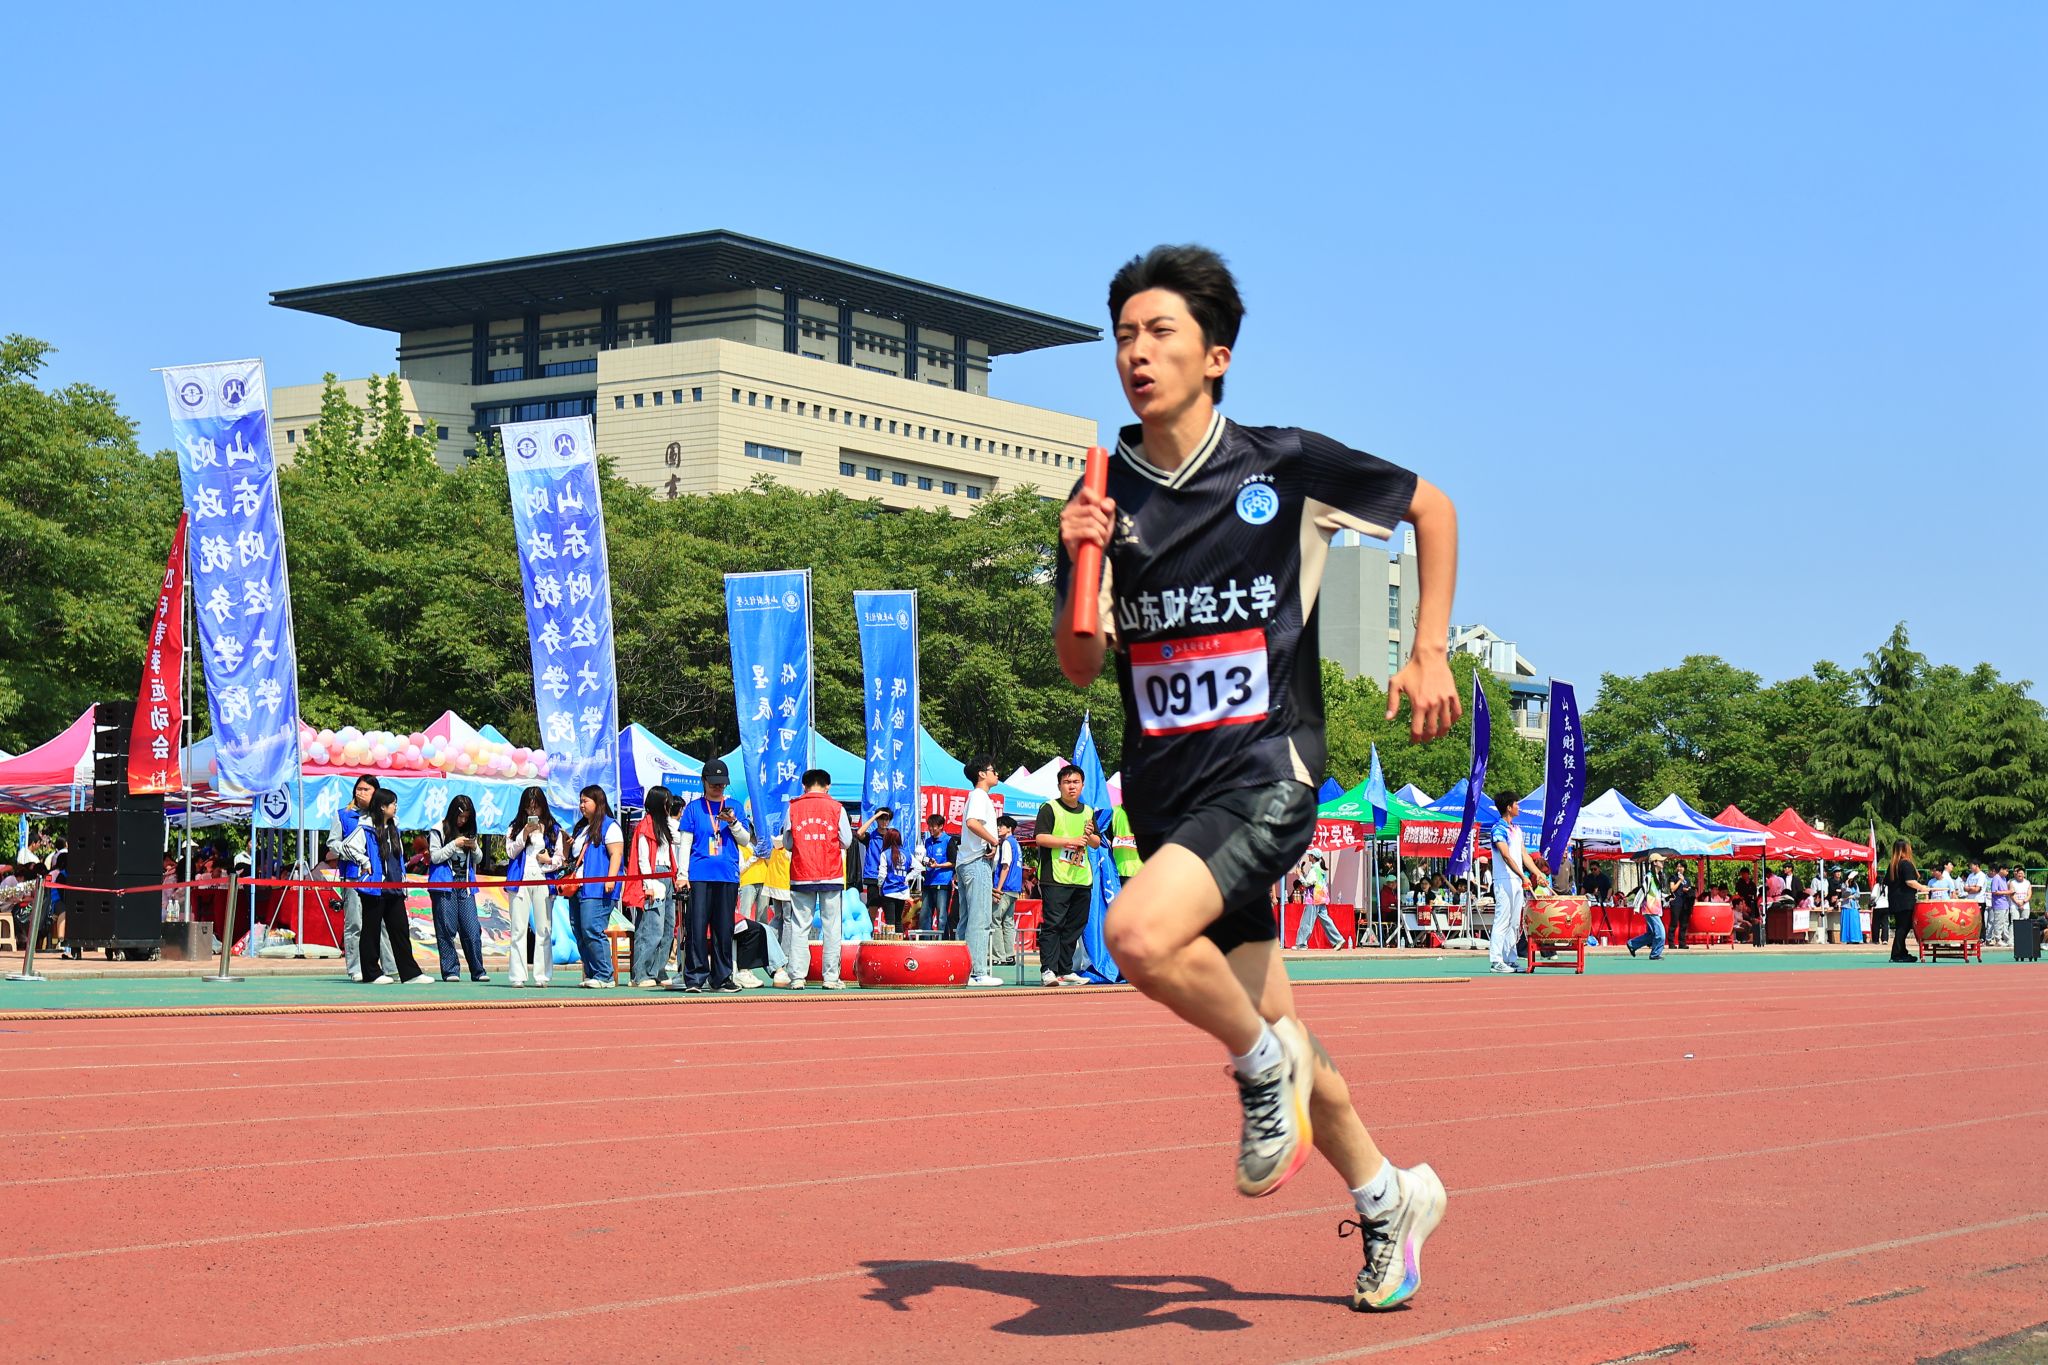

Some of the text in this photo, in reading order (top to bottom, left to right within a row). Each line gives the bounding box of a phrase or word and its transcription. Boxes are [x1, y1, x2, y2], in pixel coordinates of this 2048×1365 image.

[1117, 574, 1277, 632] 山东财经大学
[1146, 665, 1253, 718] 0913
